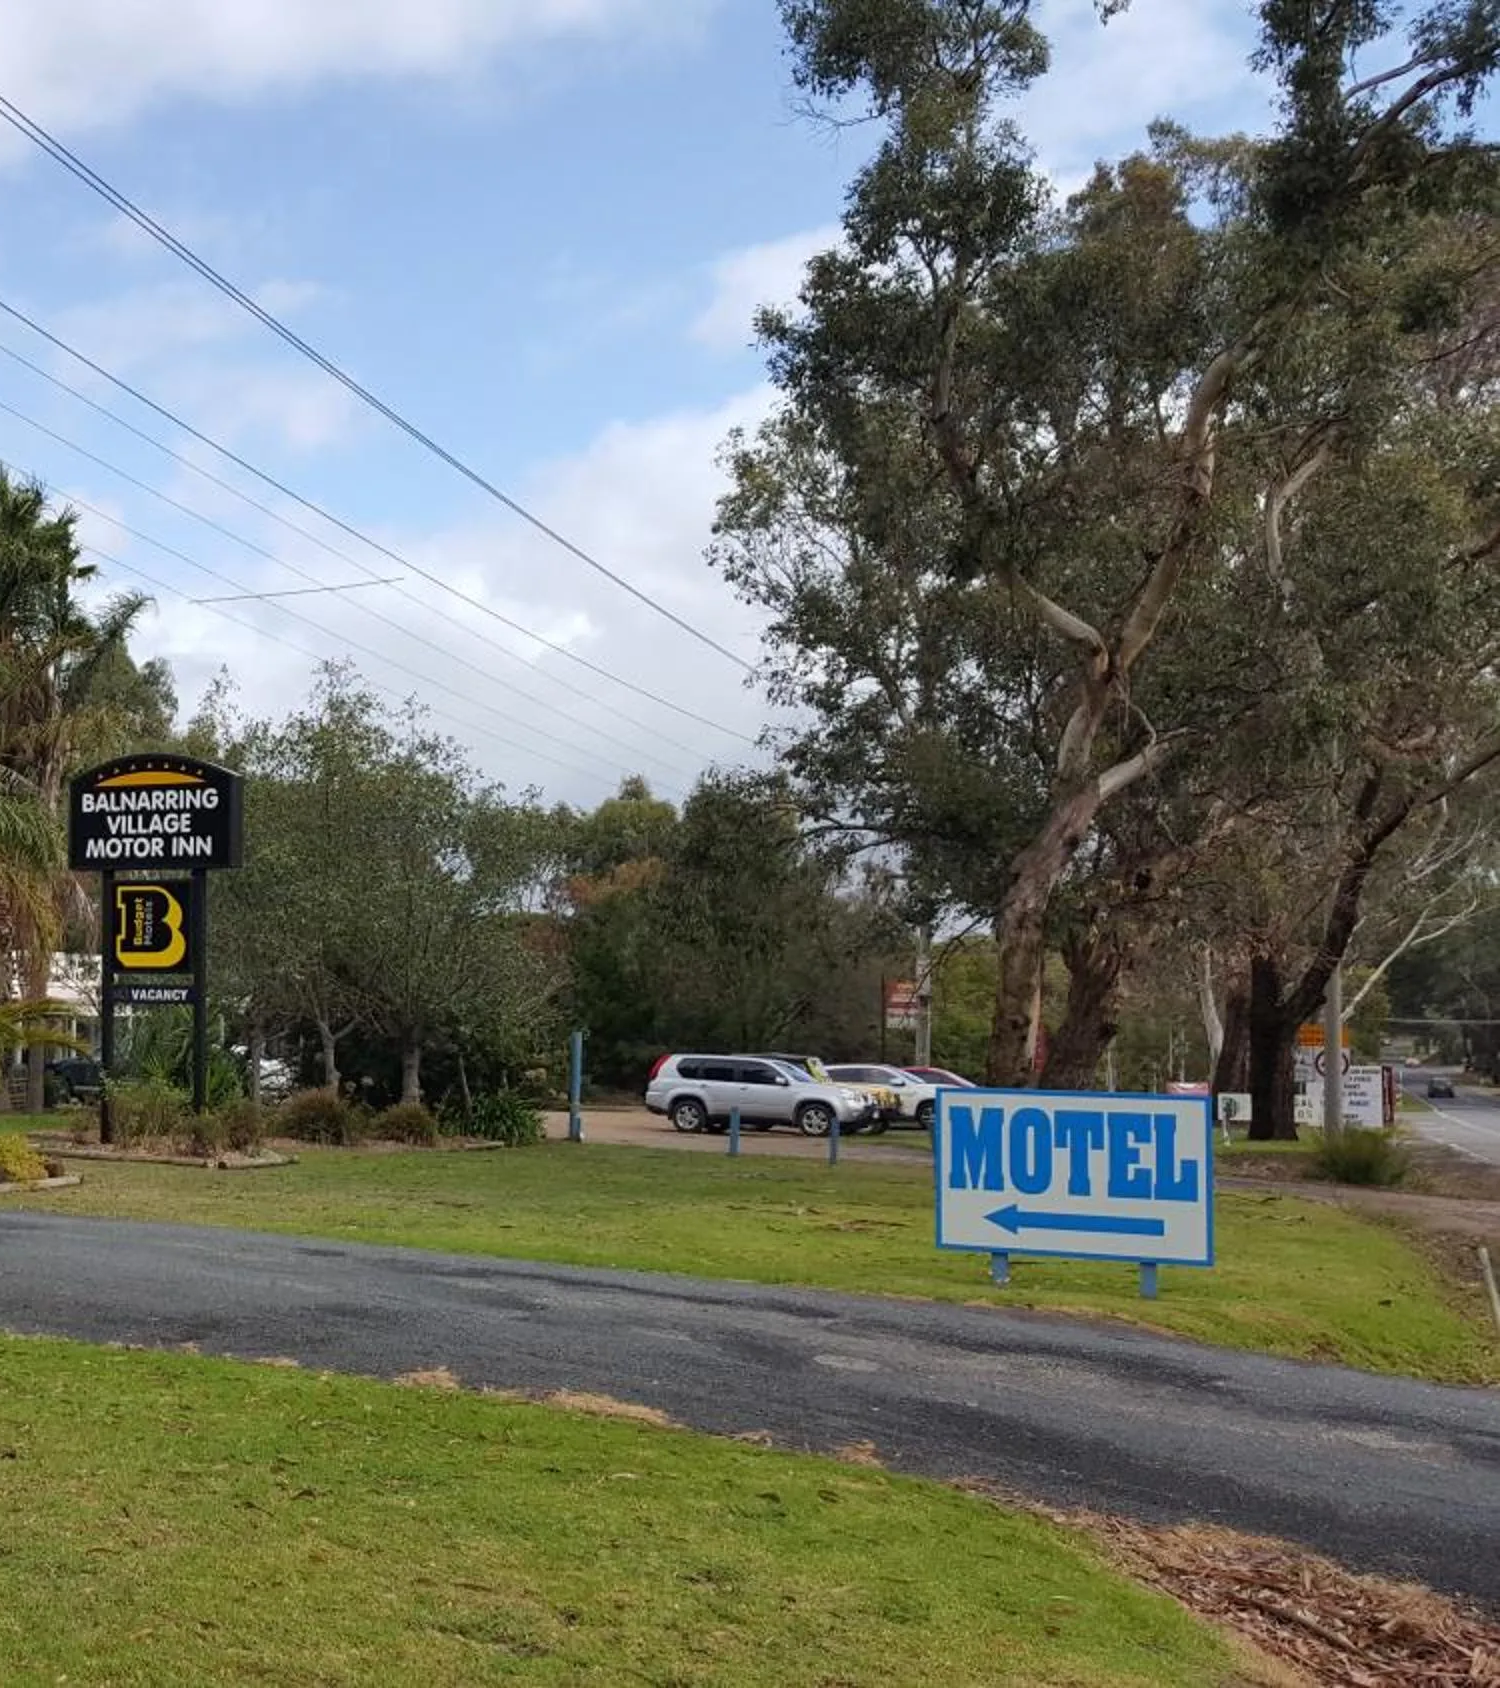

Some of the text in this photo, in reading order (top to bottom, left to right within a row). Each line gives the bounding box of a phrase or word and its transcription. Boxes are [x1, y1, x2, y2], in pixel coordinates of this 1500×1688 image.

[81, 788, 219, 813] BALNARRING
[107, 813, 191, 835] VILLAGE
[86, 836, 213, 859] MOTOR INN
[116, 885, 187, 968] B
[133, 897, 145, 946] Budget
[144, 901, 153, 946] Motels
[131, 989, 188, 1001] VACANCY
[948, 1105, 1198, 1202] MOTEL
